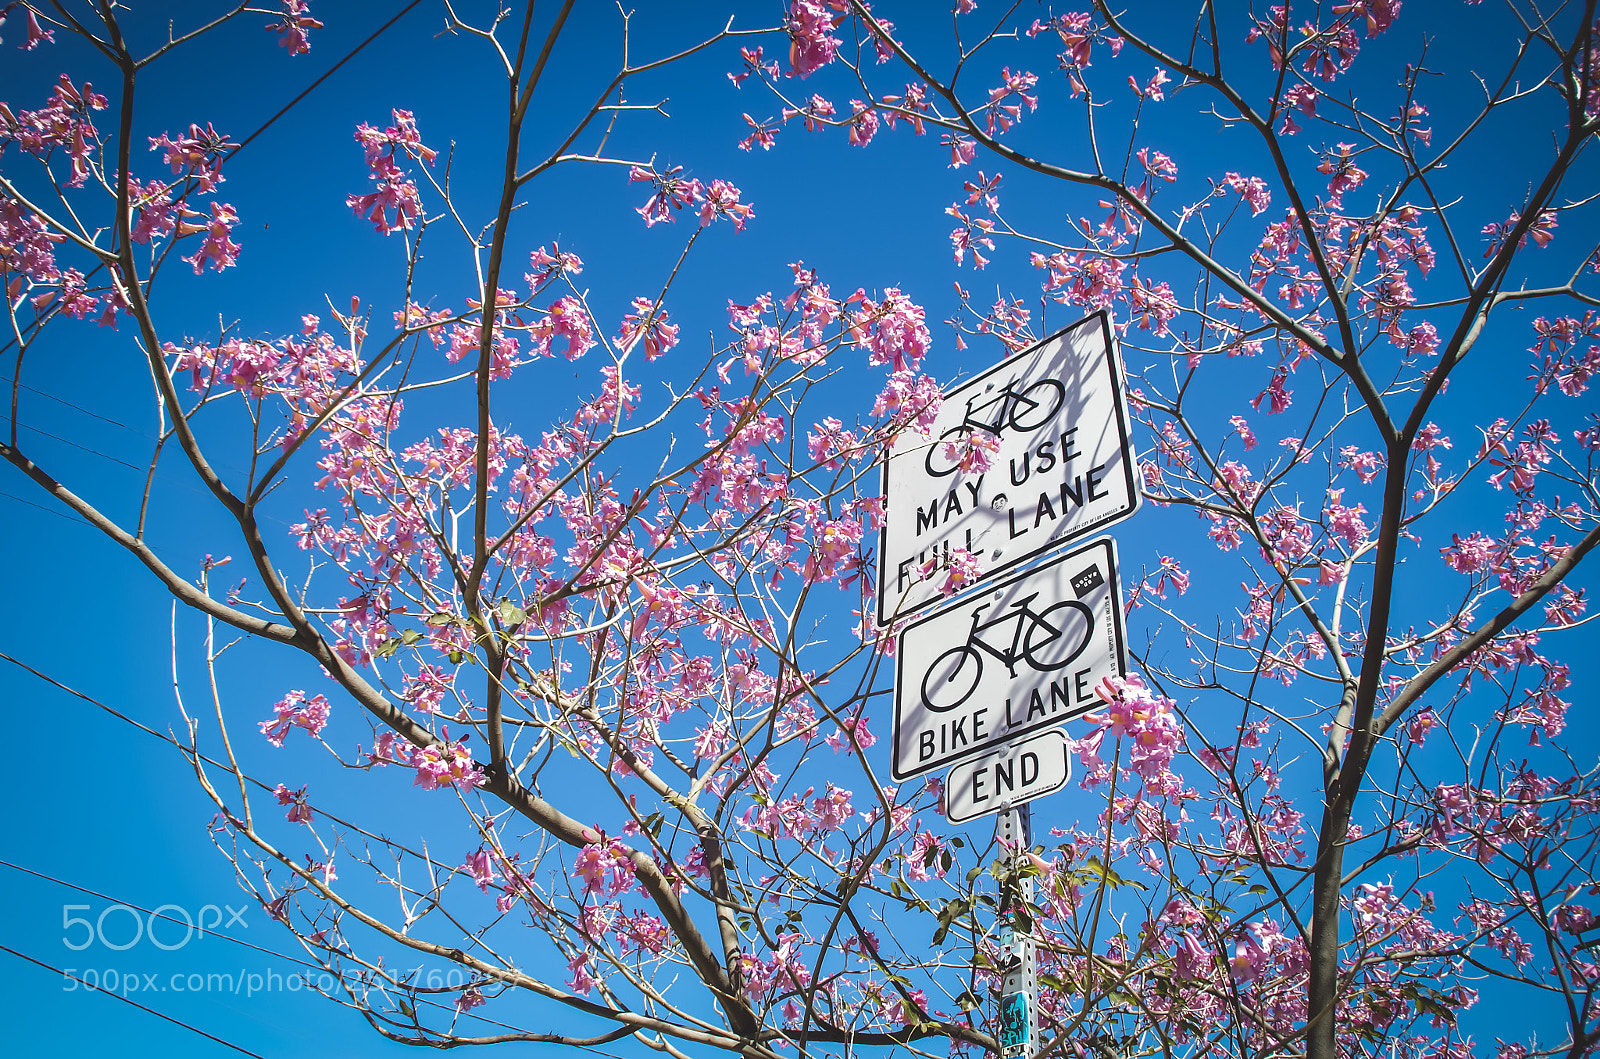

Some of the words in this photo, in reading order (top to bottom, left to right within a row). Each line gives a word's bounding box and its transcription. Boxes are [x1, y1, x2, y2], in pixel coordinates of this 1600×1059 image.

[917, 474, 984, 536] MAY
[1010, 427, 1082, 487] USE
[1008, 464, 1109, 540] LANE
[919, 708, 988, 762] BIKE
[1006, 668, 1094, 729] LANE
[973, 752, 1039, 804] END
